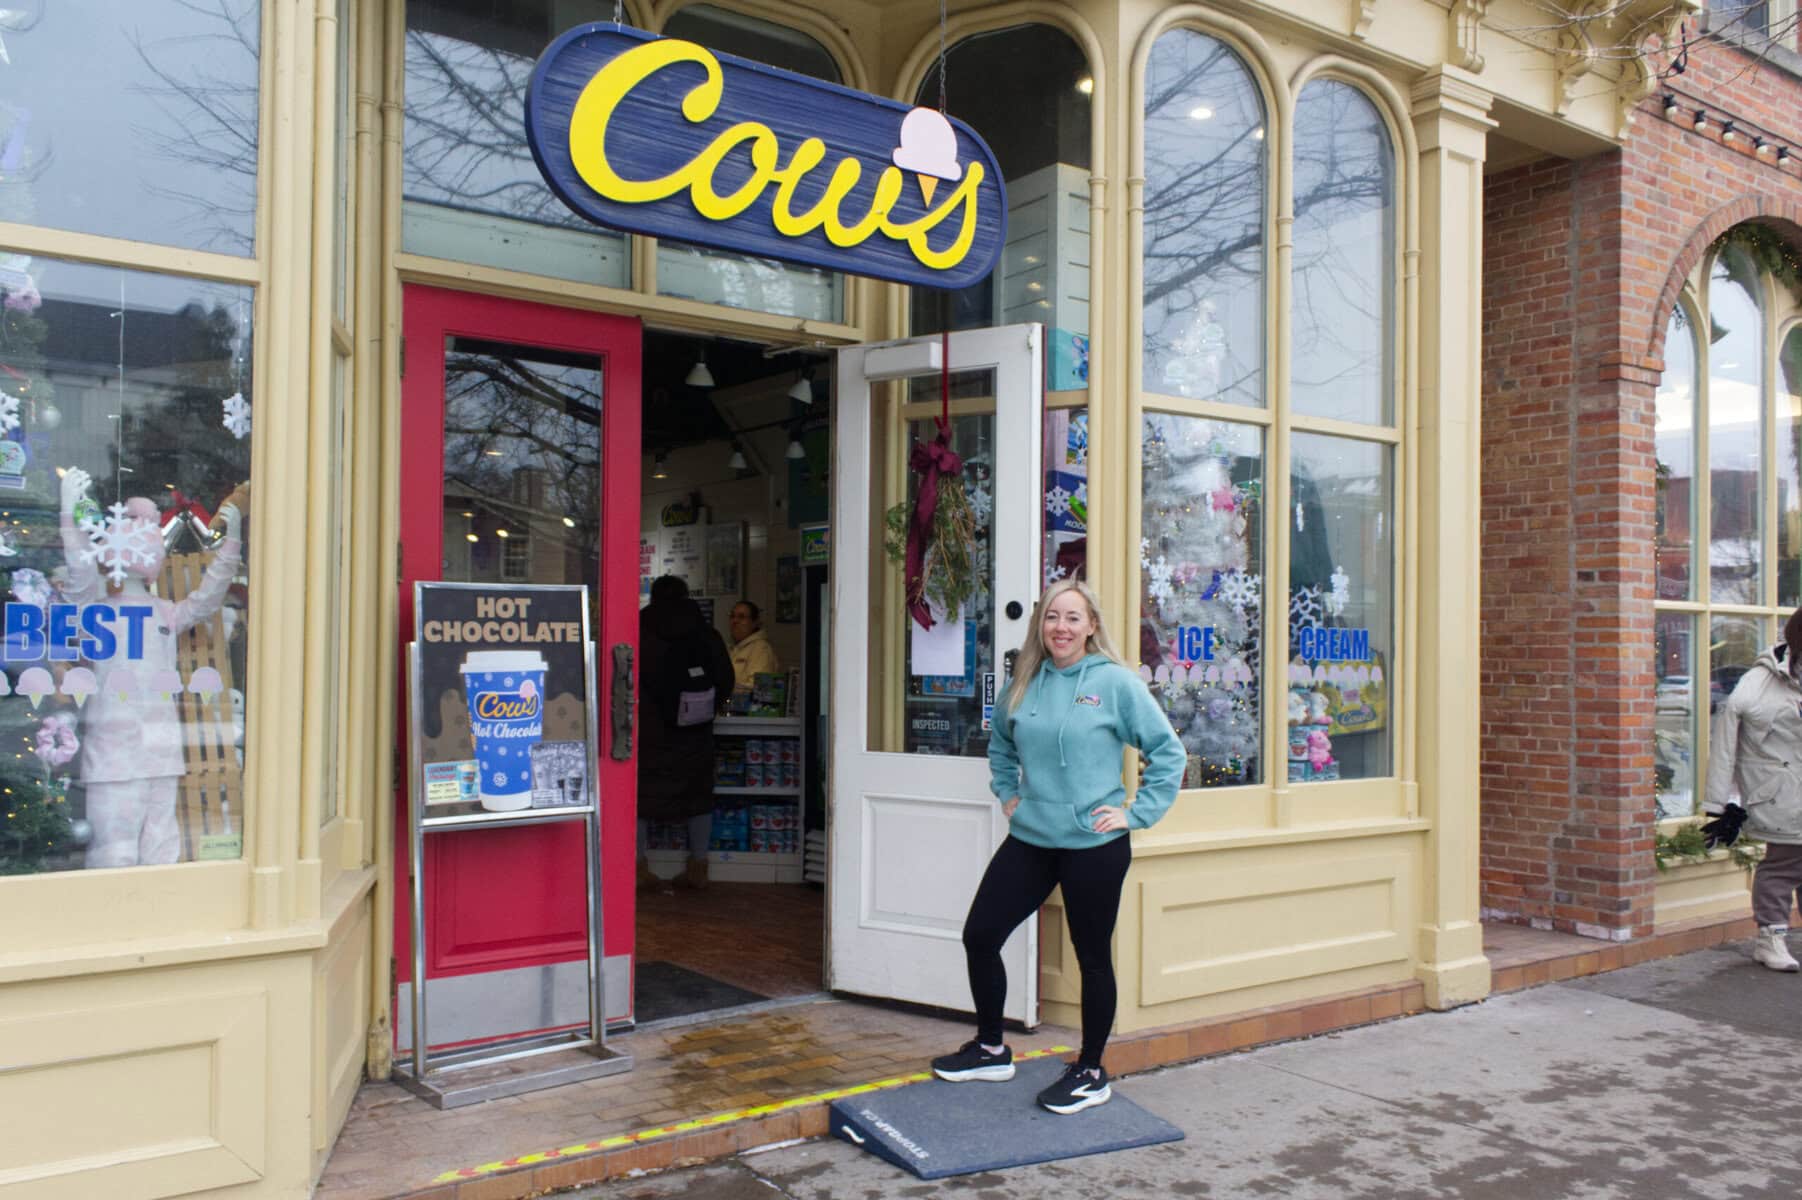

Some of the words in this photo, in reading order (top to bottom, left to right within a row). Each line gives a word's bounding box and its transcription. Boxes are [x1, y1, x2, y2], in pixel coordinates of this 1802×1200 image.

[569, 39, 984, 269] Cows
[476, 597, 531, 618] HOT
[4, 602, 154, 661] BEST
[424, 621, 580, 643] CHOCOLATE
[1178, 627, 1214, 661] ICE
[1301, 628, 1369, 661] CREAM
[985, 675, 994, 704] PUSH
[479, 692, 537, 718] Cows
[911, 719, 951, 731] INSPECTED
